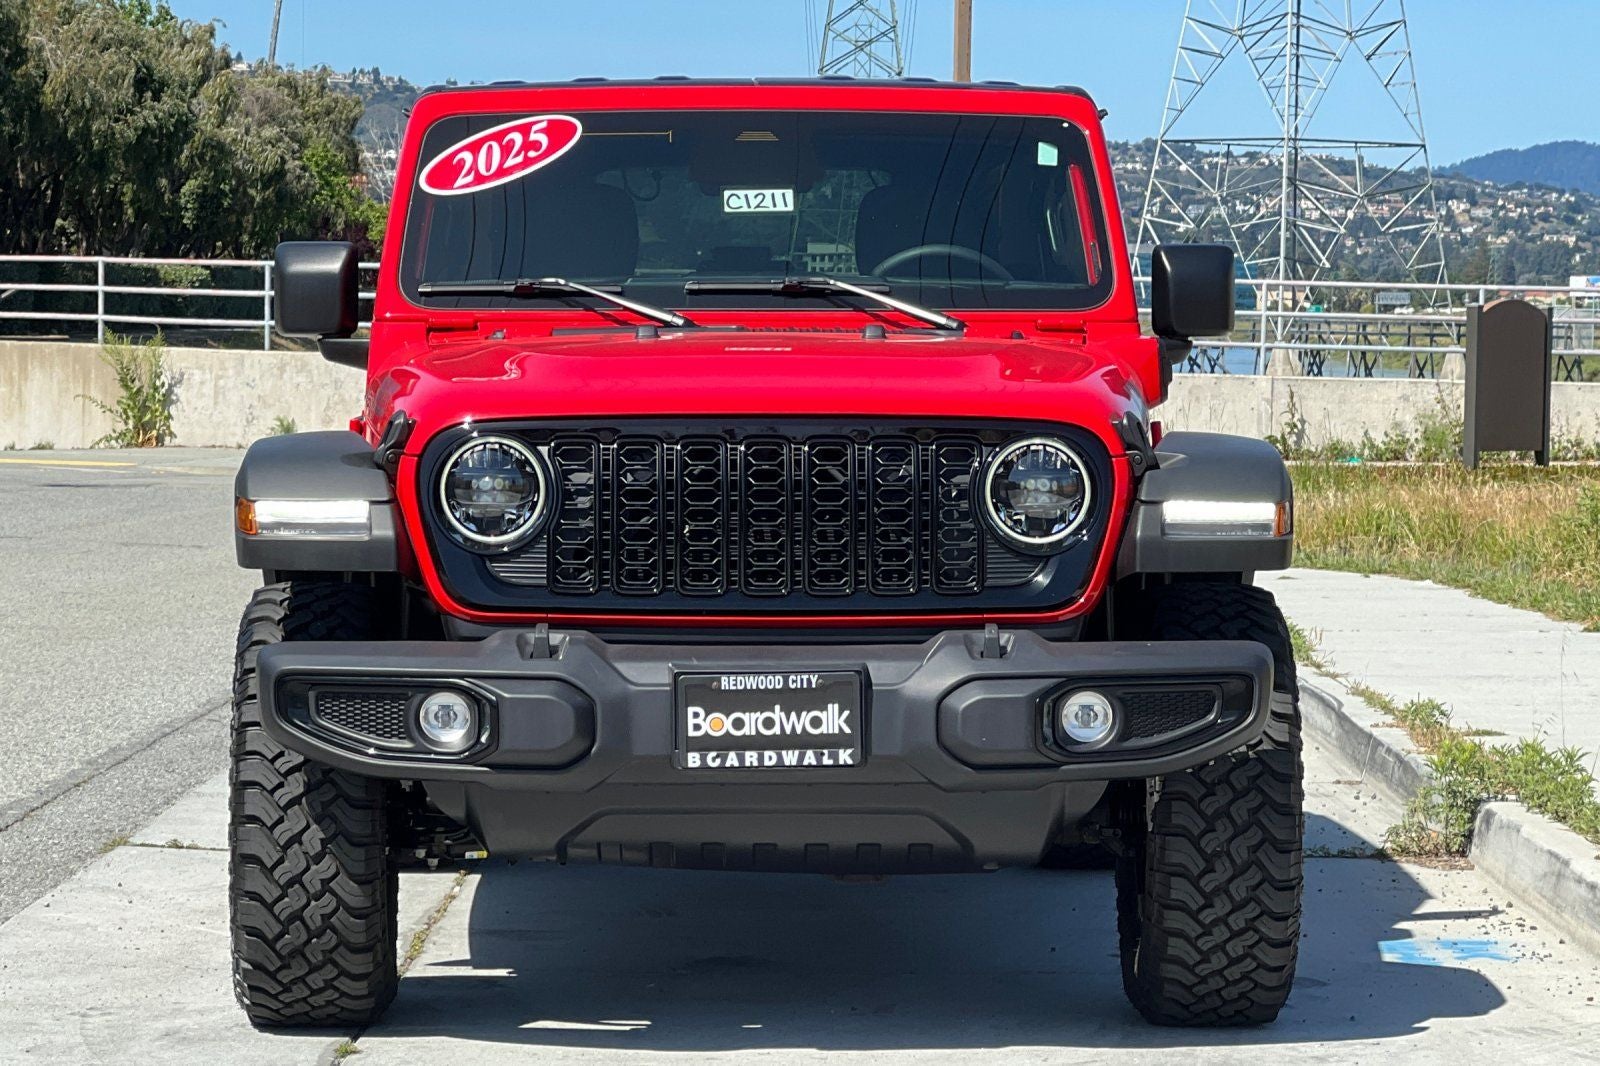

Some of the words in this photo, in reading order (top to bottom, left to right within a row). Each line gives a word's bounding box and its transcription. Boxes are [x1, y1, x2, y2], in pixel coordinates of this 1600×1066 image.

[452, 119, 549, 189] 2025
[726, 192, 788, 210] C1211
[721, 675, 783, 690] REDWOOD
[788, 674, 819, 689] CITY
[687, 703, 852, 737] Boardwalk
[687, 748, 855, 768] BOARDWALK
